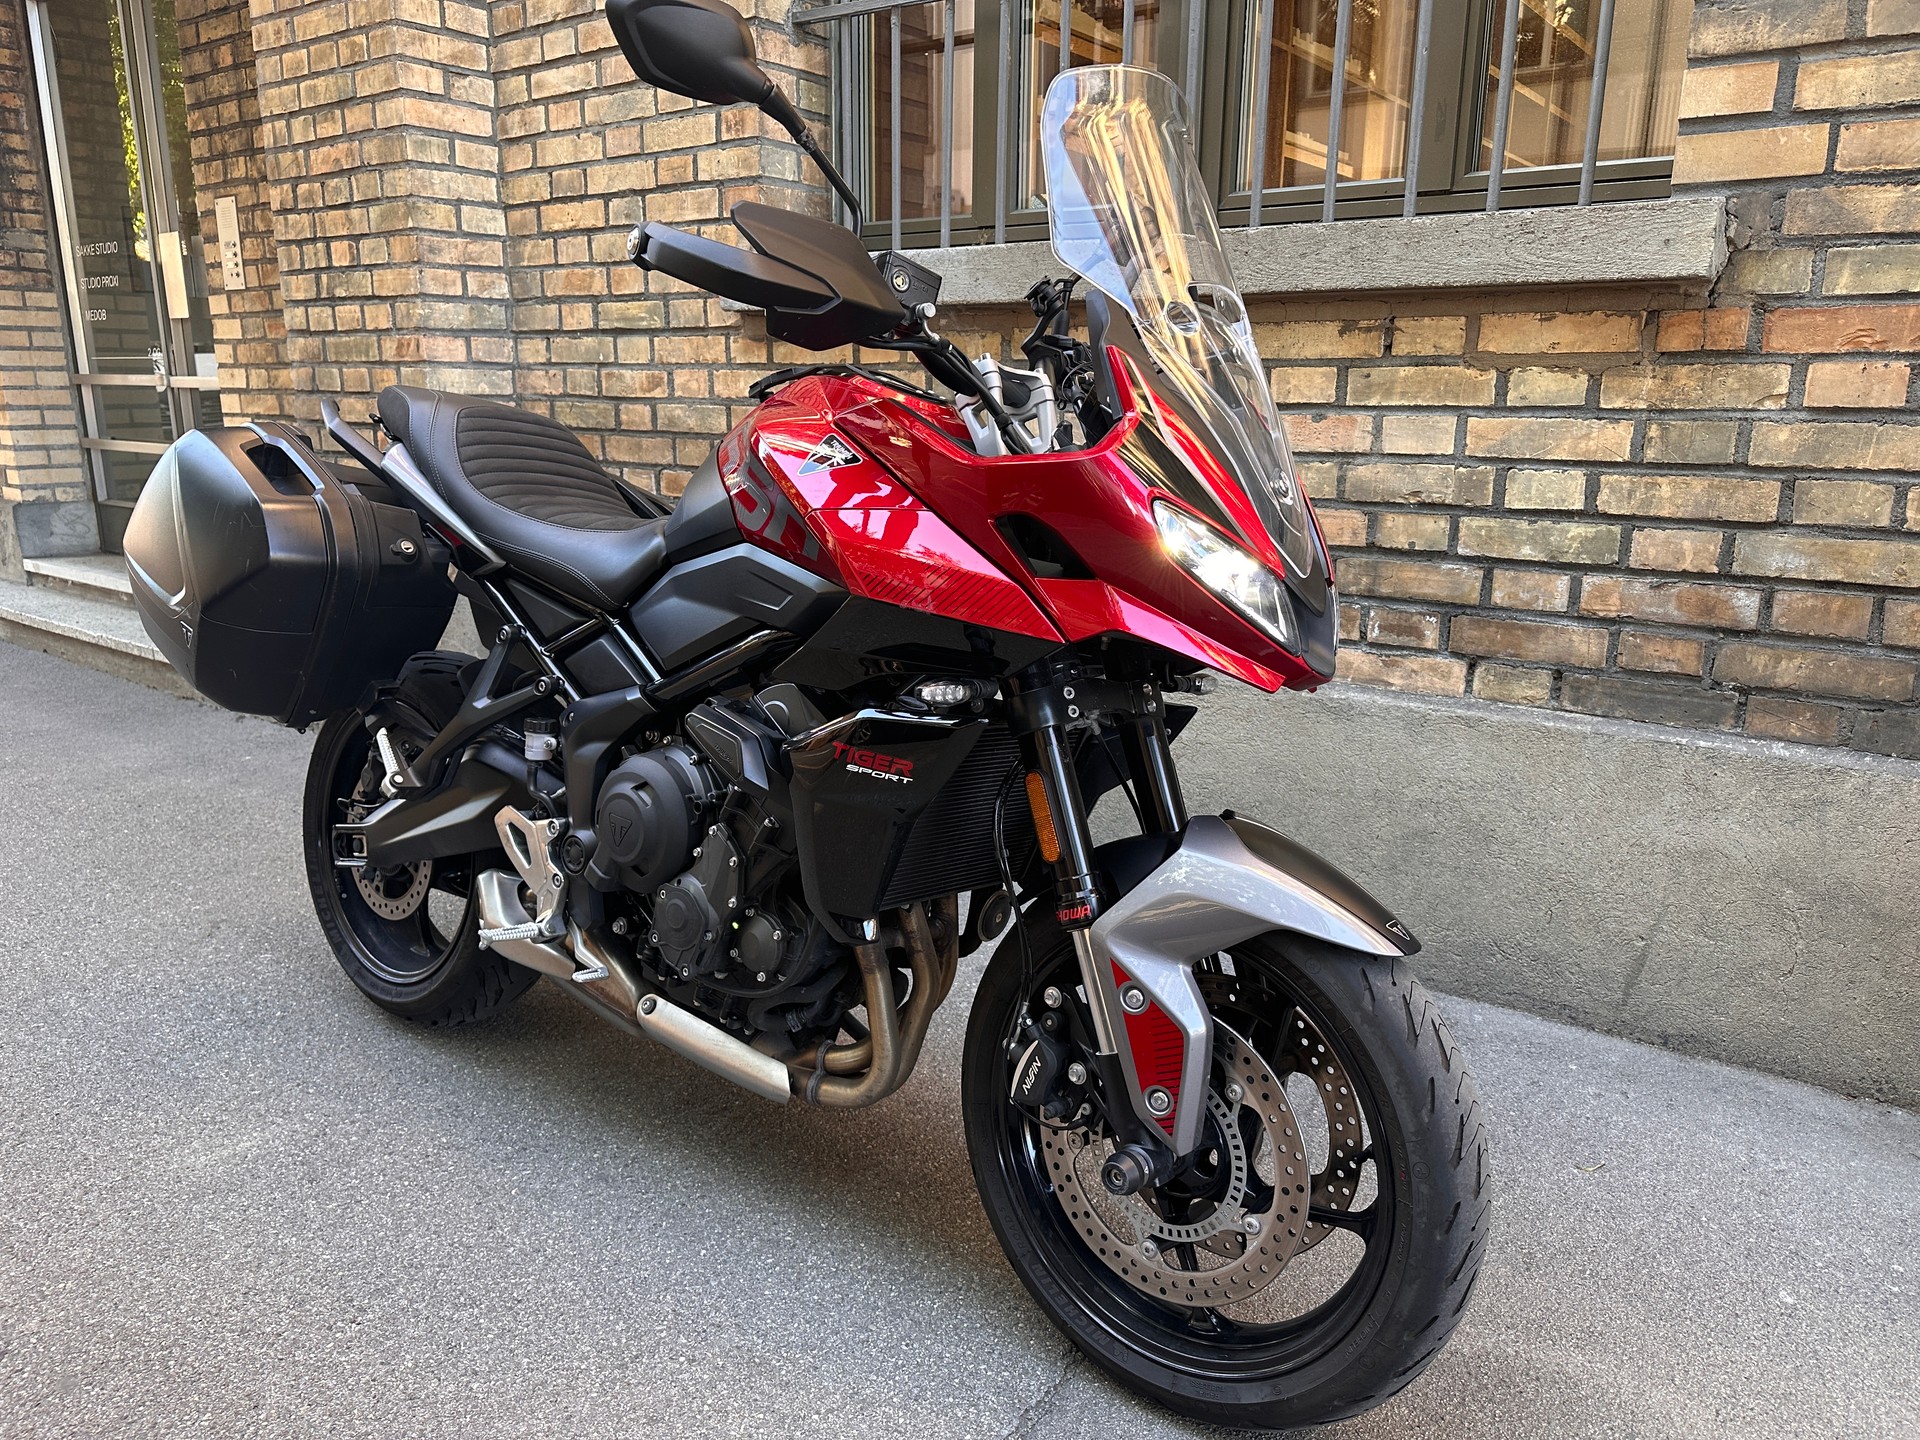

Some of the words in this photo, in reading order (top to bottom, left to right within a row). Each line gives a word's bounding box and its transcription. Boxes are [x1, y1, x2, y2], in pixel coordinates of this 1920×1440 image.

[95, 241, 119, 255] STUDIO
[80, 276, 101, 289] STUDIO
[832, 741, 914, 777] TIGER
[845, 764, 914, 784] SPORT
[1031, 1263, 1112, 1348] MICHELIN
